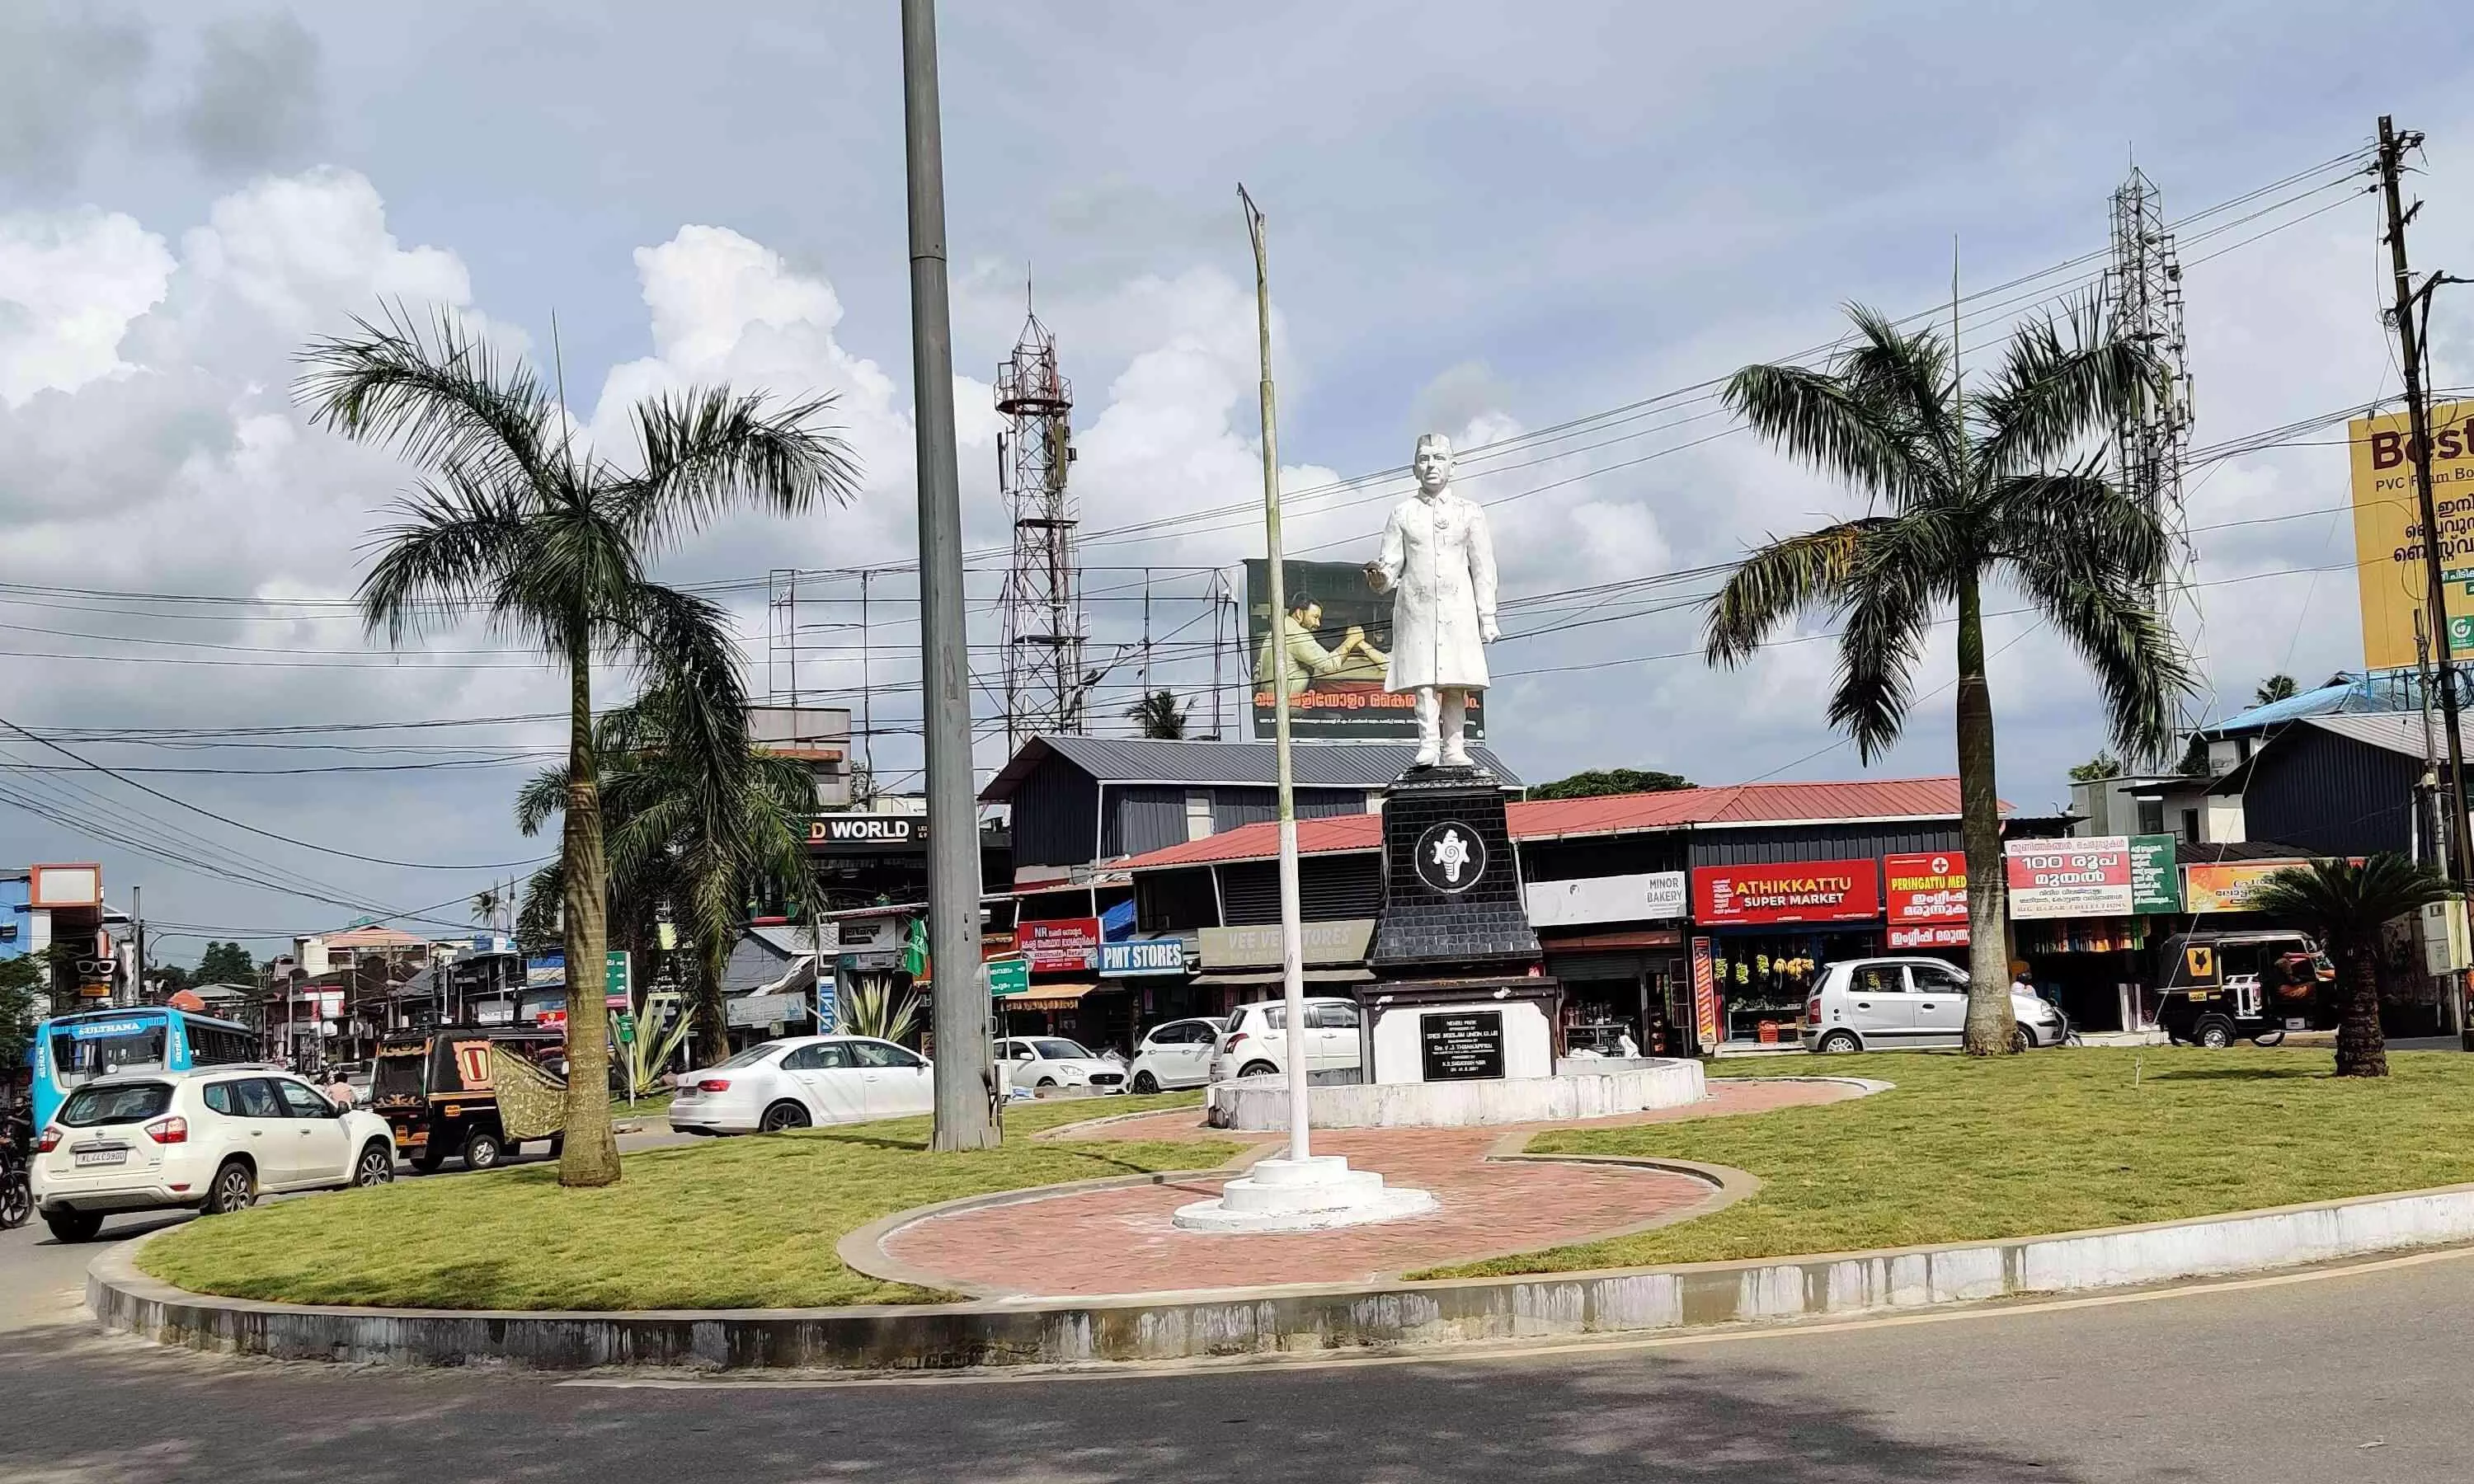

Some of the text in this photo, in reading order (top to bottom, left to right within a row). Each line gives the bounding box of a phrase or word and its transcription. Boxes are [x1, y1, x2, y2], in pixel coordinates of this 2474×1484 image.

[2376, 477, 2406, 492] PVC
[831, 821, 909, 838] WORLD
[2021, 852, 2119, 871] 100 രൂപ
[1649, 877, 1679, 889] MINOR
[1736, 876, 1851, 895] ATHIKKATTU
[2034, 869, 2105, 887] മുതൽ
[1647, 890, 1682, 903] BAKERY
[1744, 893, 1845, 908] SUPER MARKET
[1034, 927, 1048, 938] NR
[1229, 932, 1256, 949] VEE
[1103, 943, 1182, 969] PMT STORES
